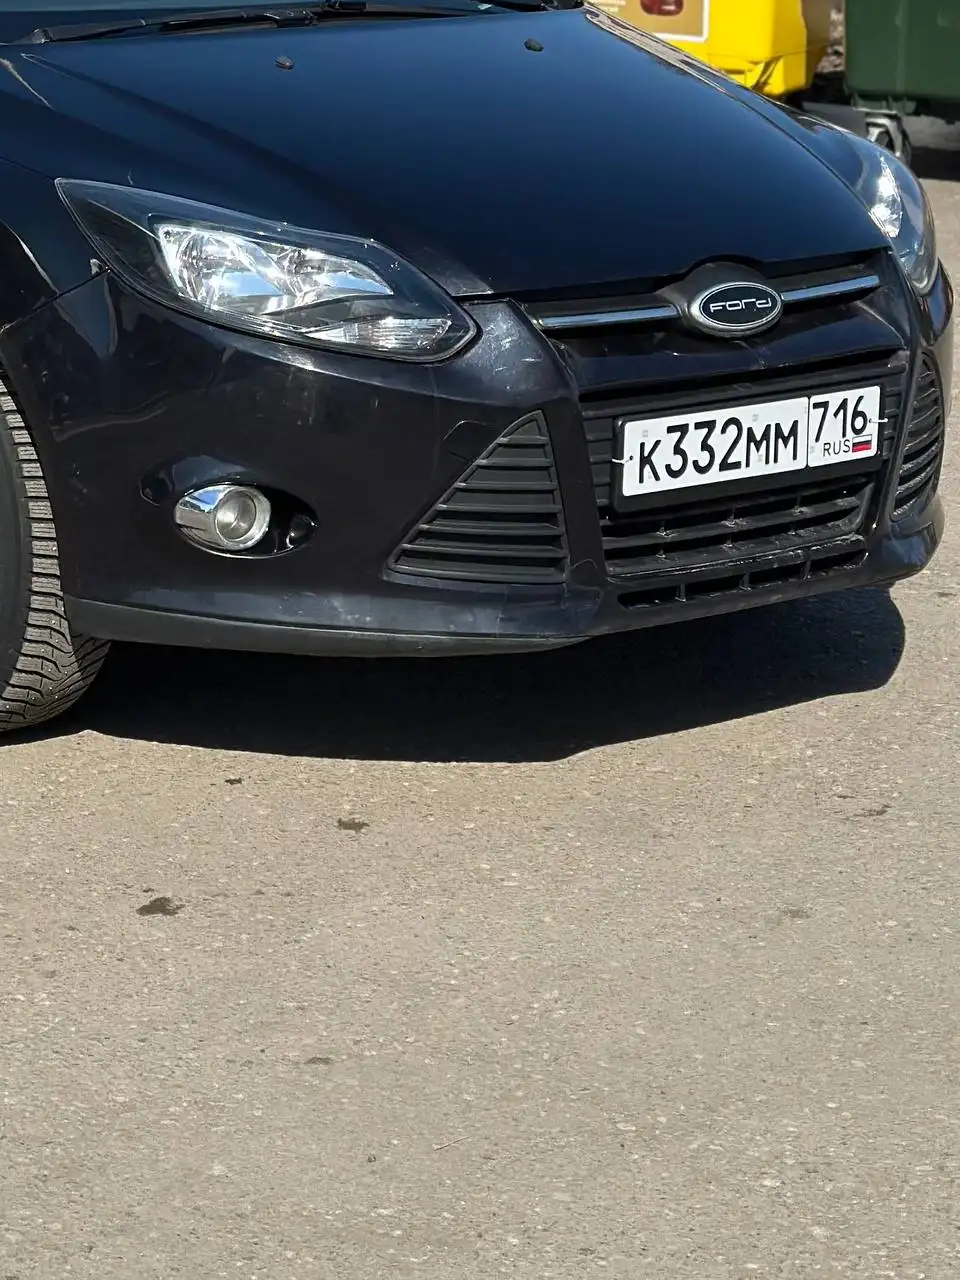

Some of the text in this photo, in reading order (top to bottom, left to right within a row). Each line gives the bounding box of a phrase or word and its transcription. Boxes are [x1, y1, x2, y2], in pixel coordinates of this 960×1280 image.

[638, 395, 868, 484] К332ММ 716
[822, 439, 851, 457] RUS
